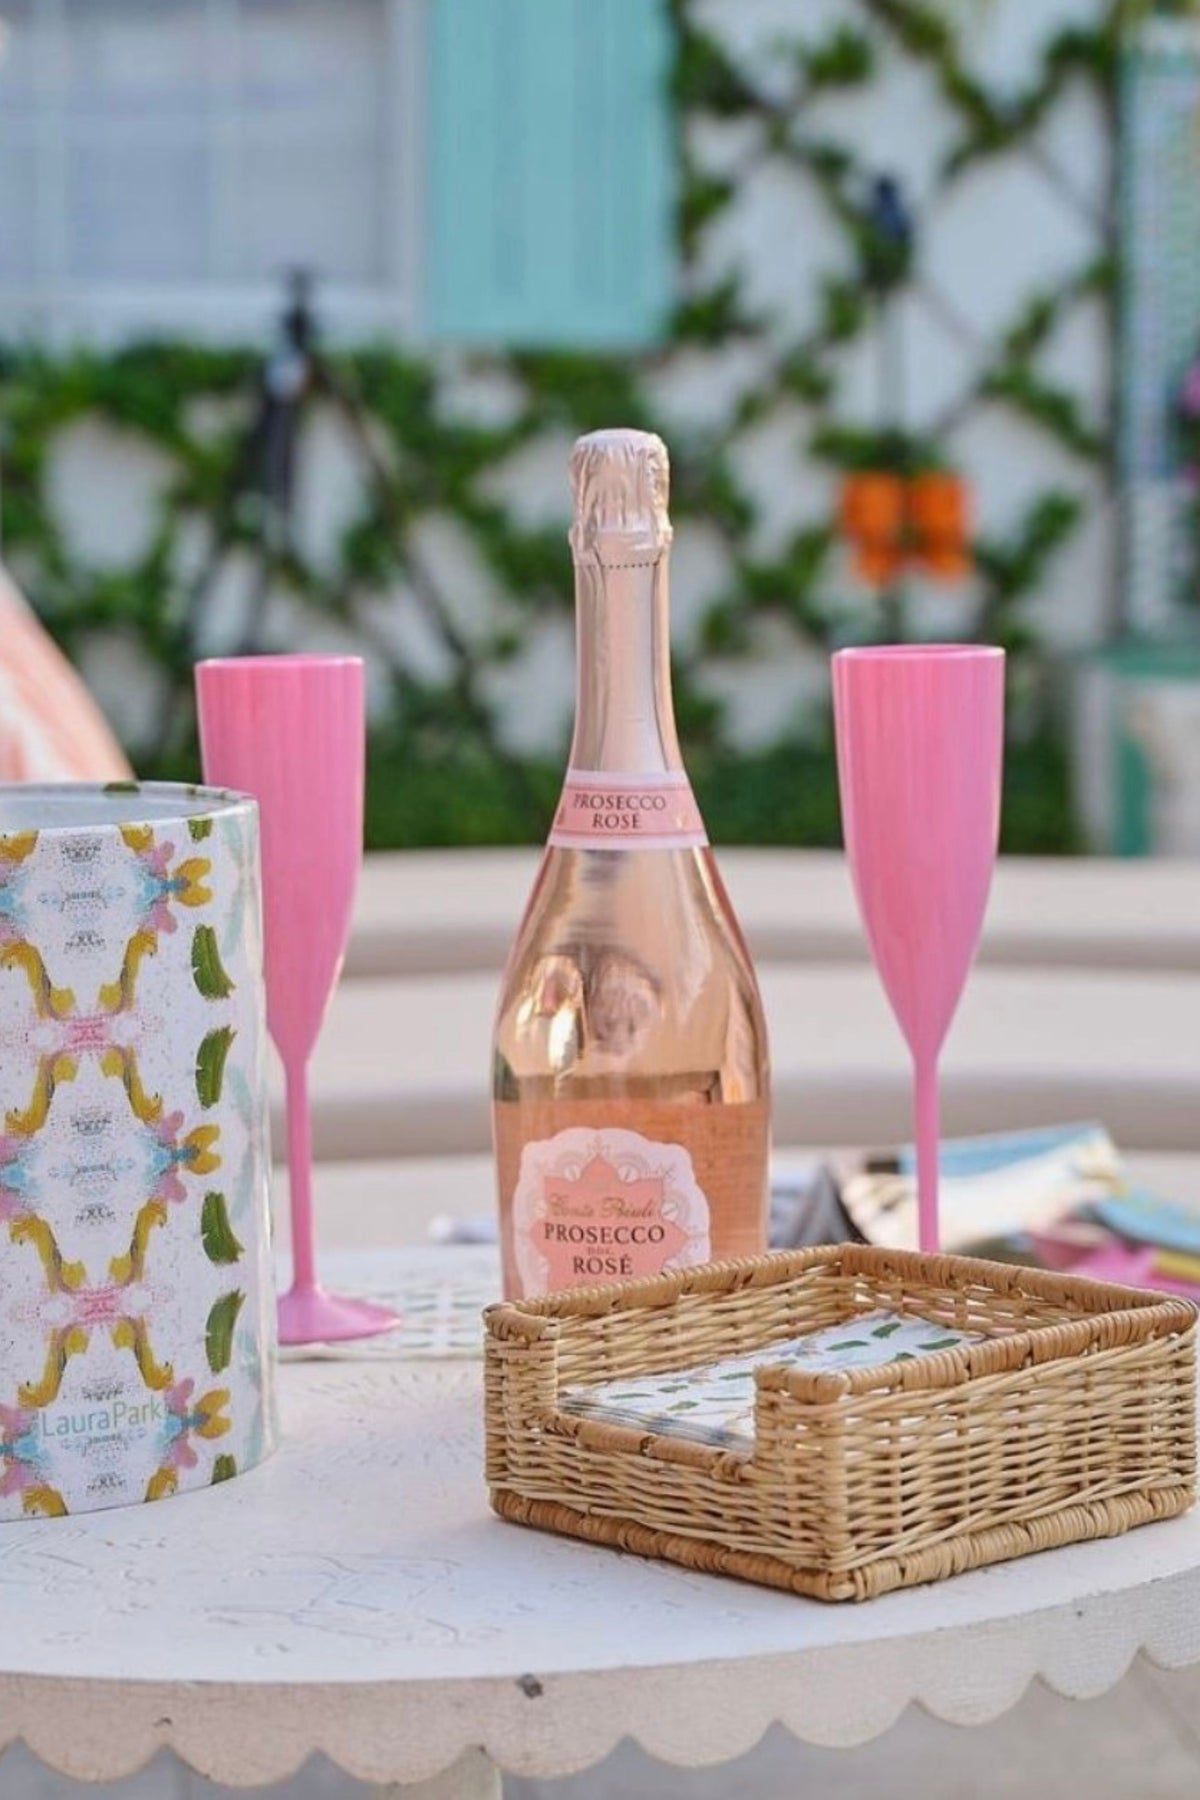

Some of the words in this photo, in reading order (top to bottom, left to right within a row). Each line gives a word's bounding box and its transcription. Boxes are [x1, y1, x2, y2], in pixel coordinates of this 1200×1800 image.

[573, 793, 666, 811] PROSECCO
[544, 1222, 665, 1244] PROSECCO
[573, 1254, 633, 1275] ROSÉ
[42, 1395, 161, 1437] LauraPark
